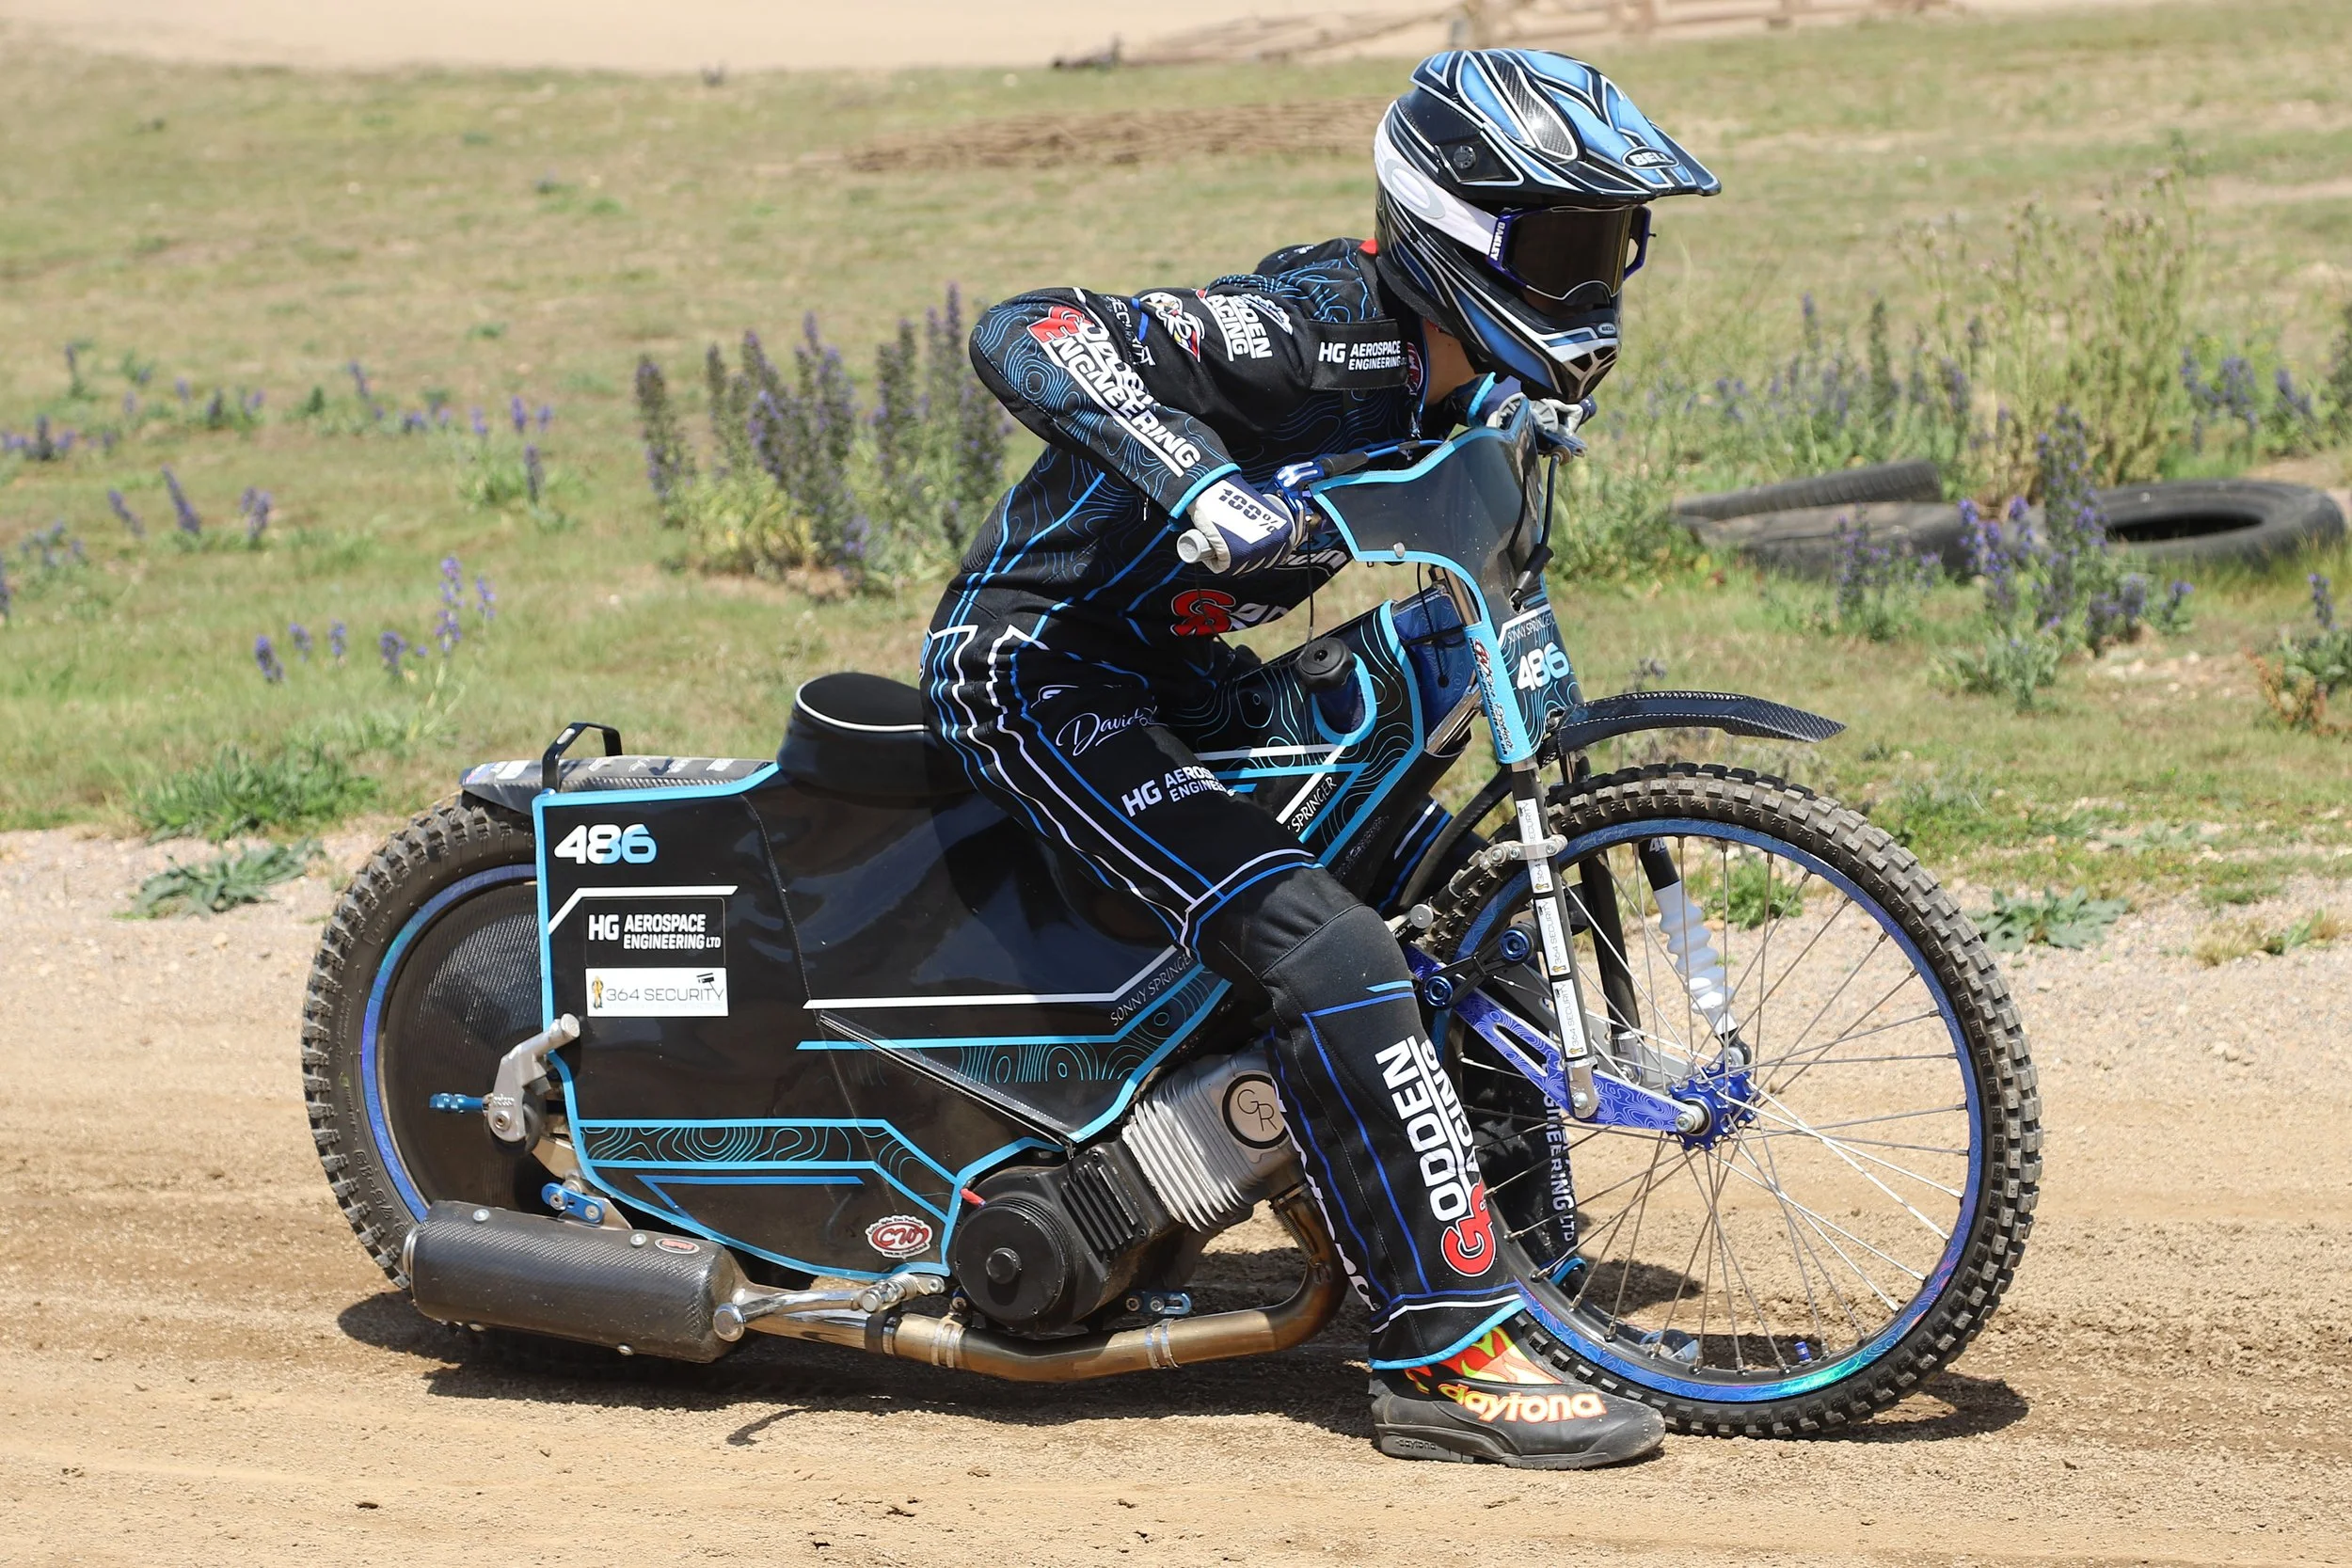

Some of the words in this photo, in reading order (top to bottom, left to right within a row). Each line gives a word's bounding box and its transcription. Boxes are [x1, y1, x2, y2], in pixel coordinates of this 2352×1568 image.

[1629, 151, 1674, 166] BELL
[1490, 222, 1505, 261] OAKLEY
[1318, 341, 1346, 363] HG
[1350, 341, 1401, 357] AEROSPACE
[1348, 356, 1401, 371] ENGINEERING
[1218, 488, 1278, 532] 100%
[1517, 641, 1570, 691] 486
[1120, 780, 1163, 817] HG
[1291, 776, 1337, 833] SPRINGER
[553, 823, 658, 864] 486
[588, 914, 619, 941] HG
[624, 913, 706, 932] AEROSPACE
[1540, 899, 1560, 944] SECURITY
[623, 933, 706, 950] ENGINEERING
[706, 937, 722, 949] LTD
[1551, 945, 1562, 967] 364
[606, 989, 640, 1002] 364
[644, 989, 724, 1002] SECURITY
[1110, 988, 1147, 1026] SONNY
[1558, 983, 1576, 1027] SECURITY
[1570, 1028, 1579, 1047] 364
[1237, 1088, 1278, 1132] GR
[1558, 1213, 1576, 1243] LTD
[1438, 1383, 1608, 1423] daytona
[1396, 1439, 1437, 1450] daytona
